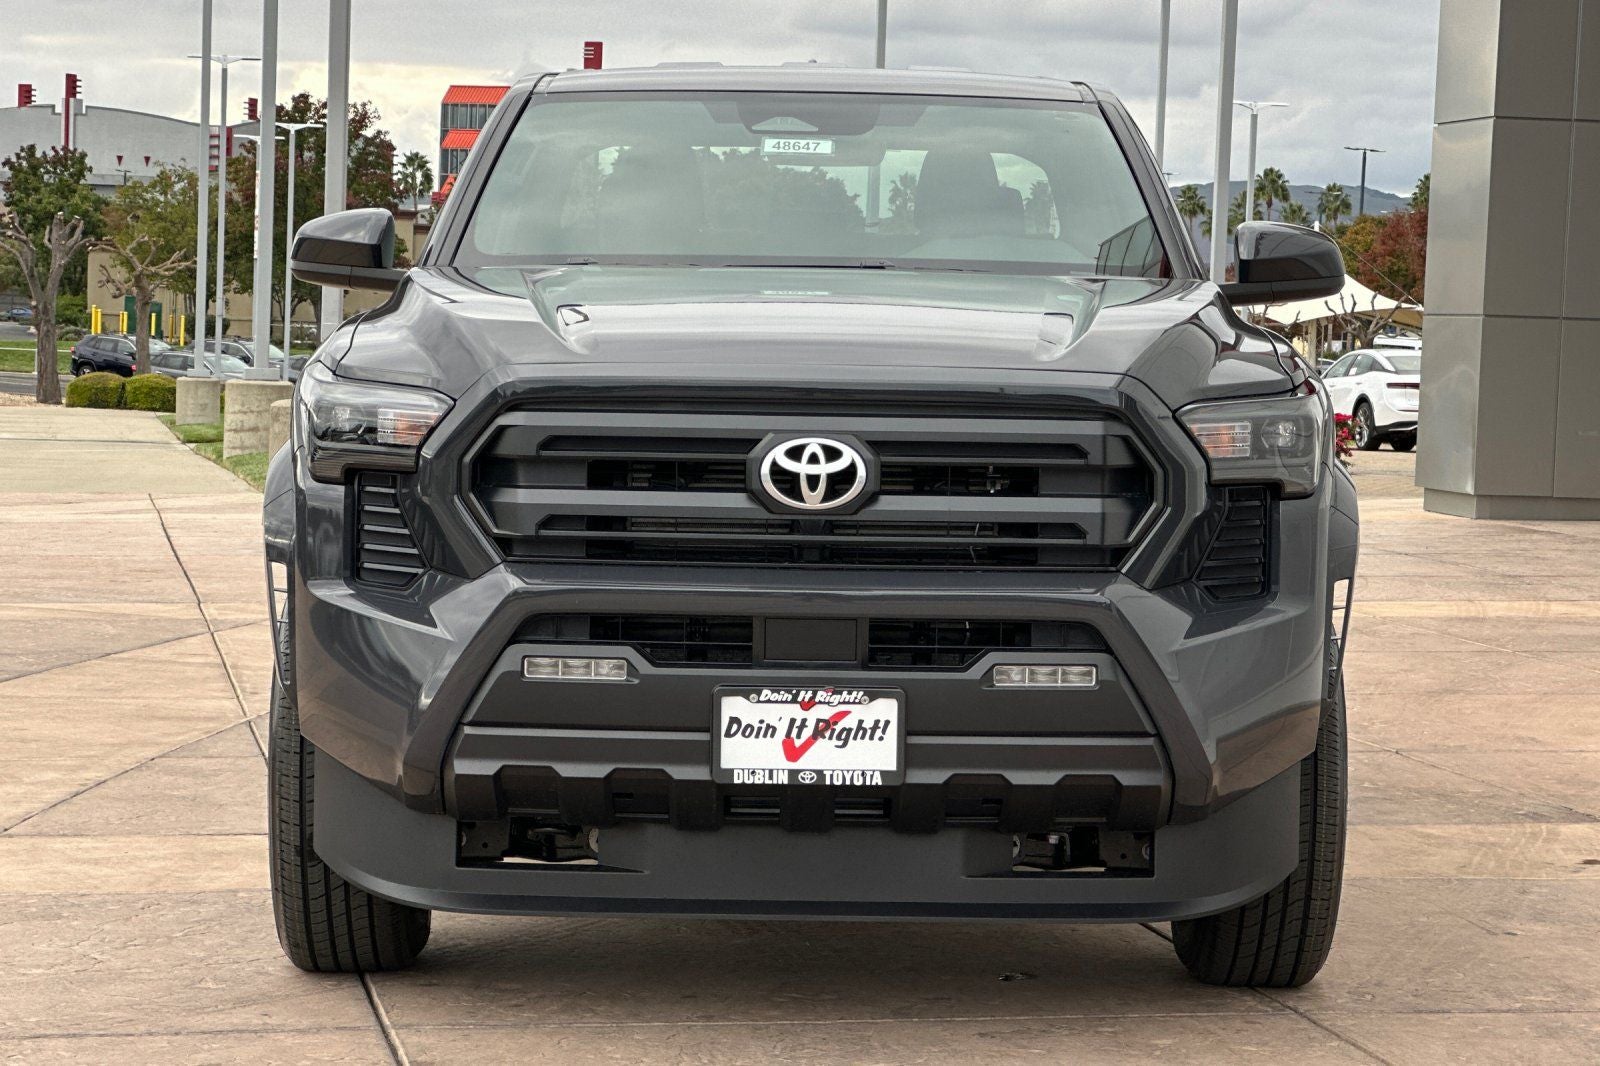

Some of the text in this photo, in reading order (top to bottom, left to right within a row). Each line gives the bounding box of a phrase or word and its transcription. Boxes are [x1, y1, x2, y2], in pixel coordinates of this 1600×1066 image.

[772, 141, 821, 152] 48647
[758, 689, 864, 707] Doin' It Right!
[723, 716, 891, 749] Doin' It Right!
[733, 769, 882, 786] DUBLIN TOYOTA
